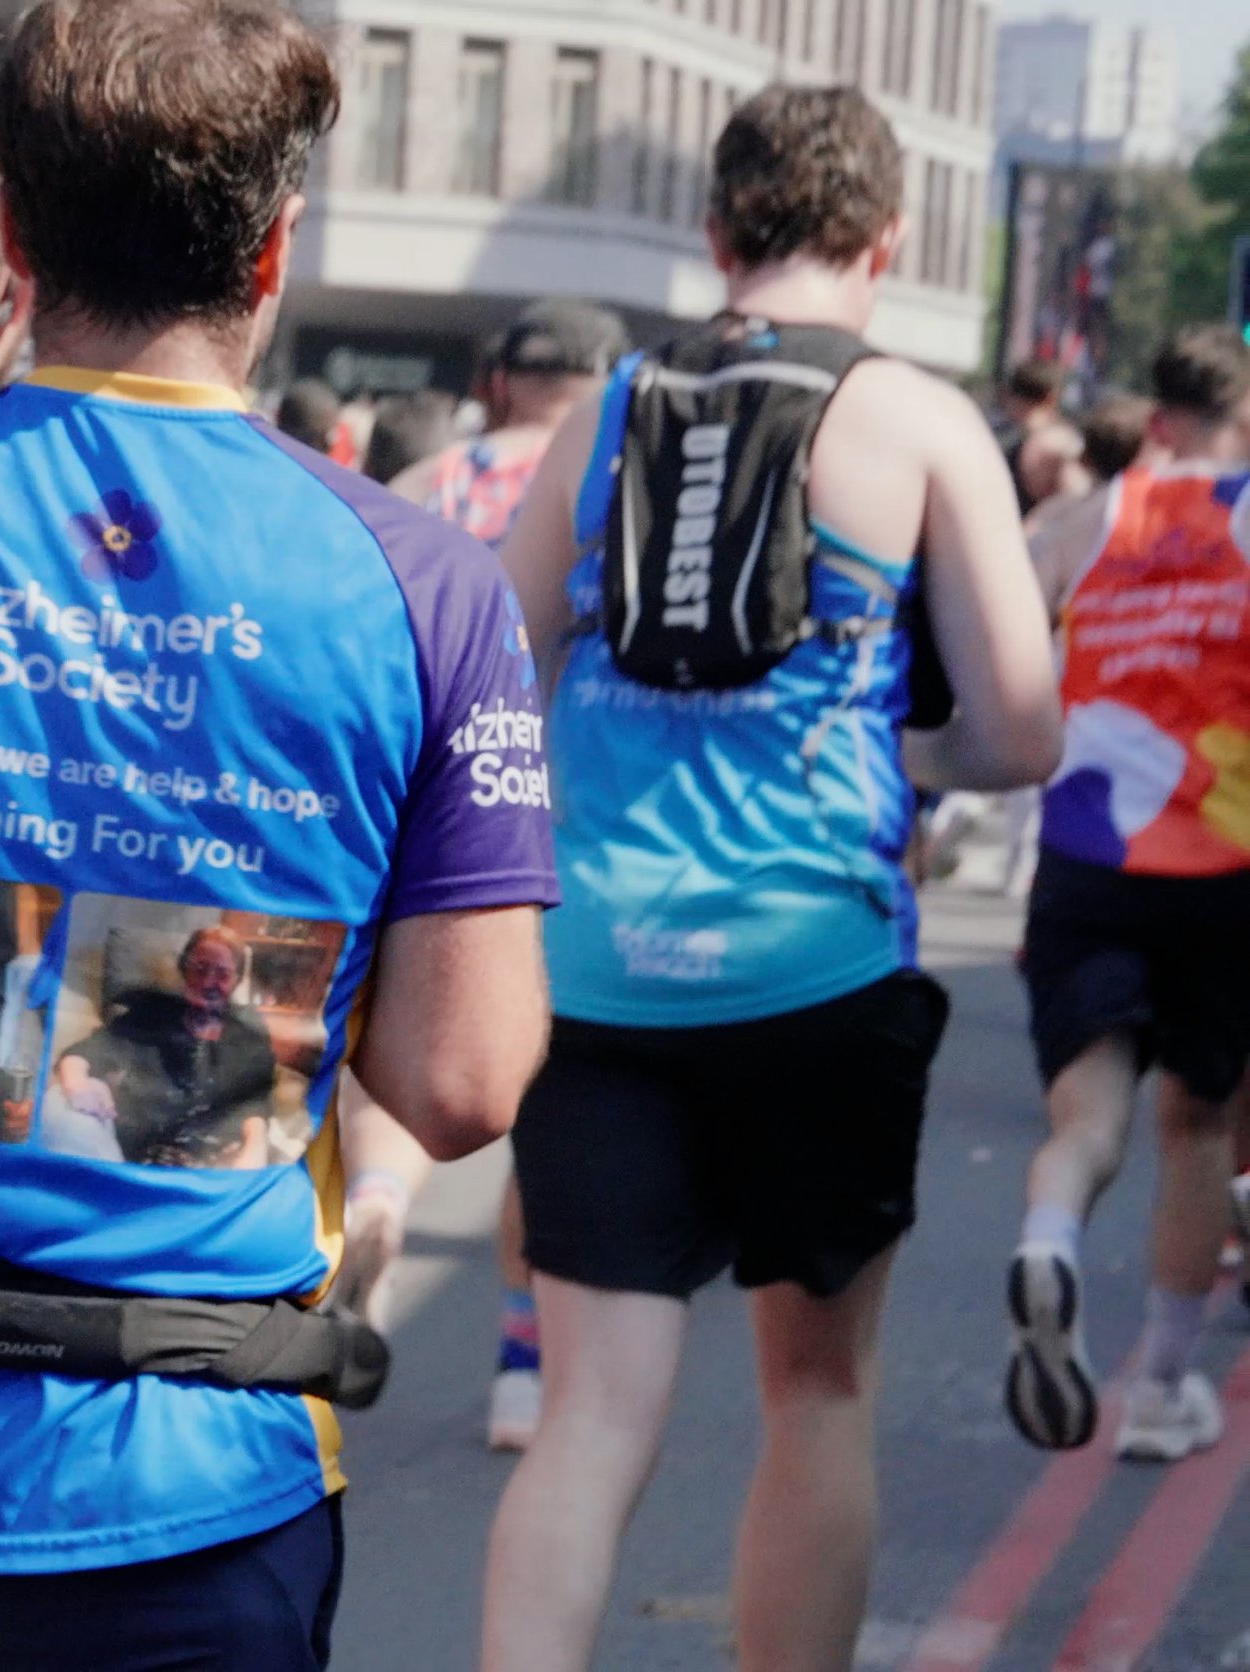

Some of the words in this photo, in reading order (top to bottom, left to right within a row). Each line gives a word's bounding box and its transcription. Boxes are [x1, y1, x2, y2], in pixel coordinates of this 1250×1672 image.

[662, 423, 730, 632] UTOBEST
[58, 757, 117, 789] are
[121, 761, 207, 807] help
[213, 771, 241, 805] &
[247, 776, 341, 823] hope
[92, 813, 168, 860] For
[176, 834, 266, 876] you
